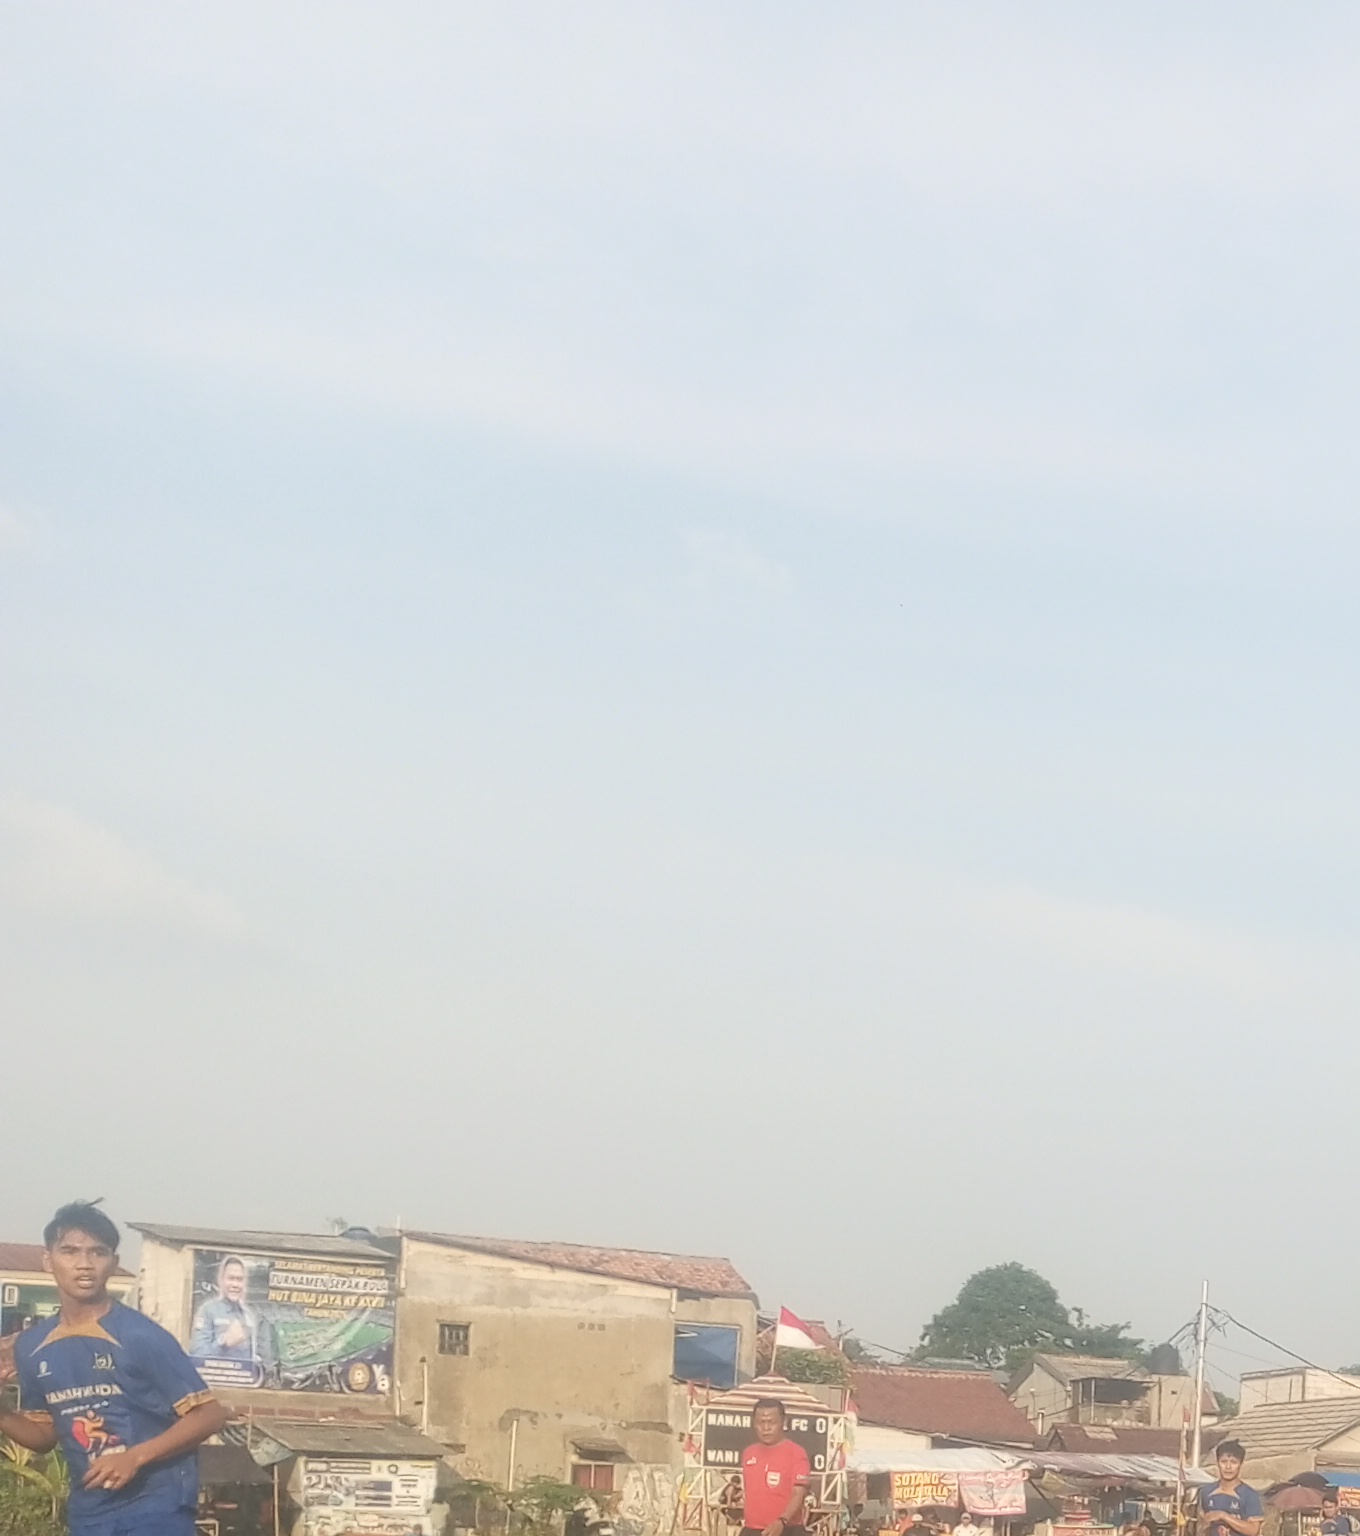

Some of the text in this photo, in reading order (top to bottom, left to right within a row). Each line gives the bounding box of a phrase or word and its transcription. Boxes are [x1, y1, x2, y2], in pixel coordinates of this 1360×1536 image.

[270, 1273, 327, 1289] TURNAMEN
[329, 1278, 361, 1290] SEPAK
[316, 1292, 342, 1307] JAYA
[791, 1418, 809, 1432] FC
